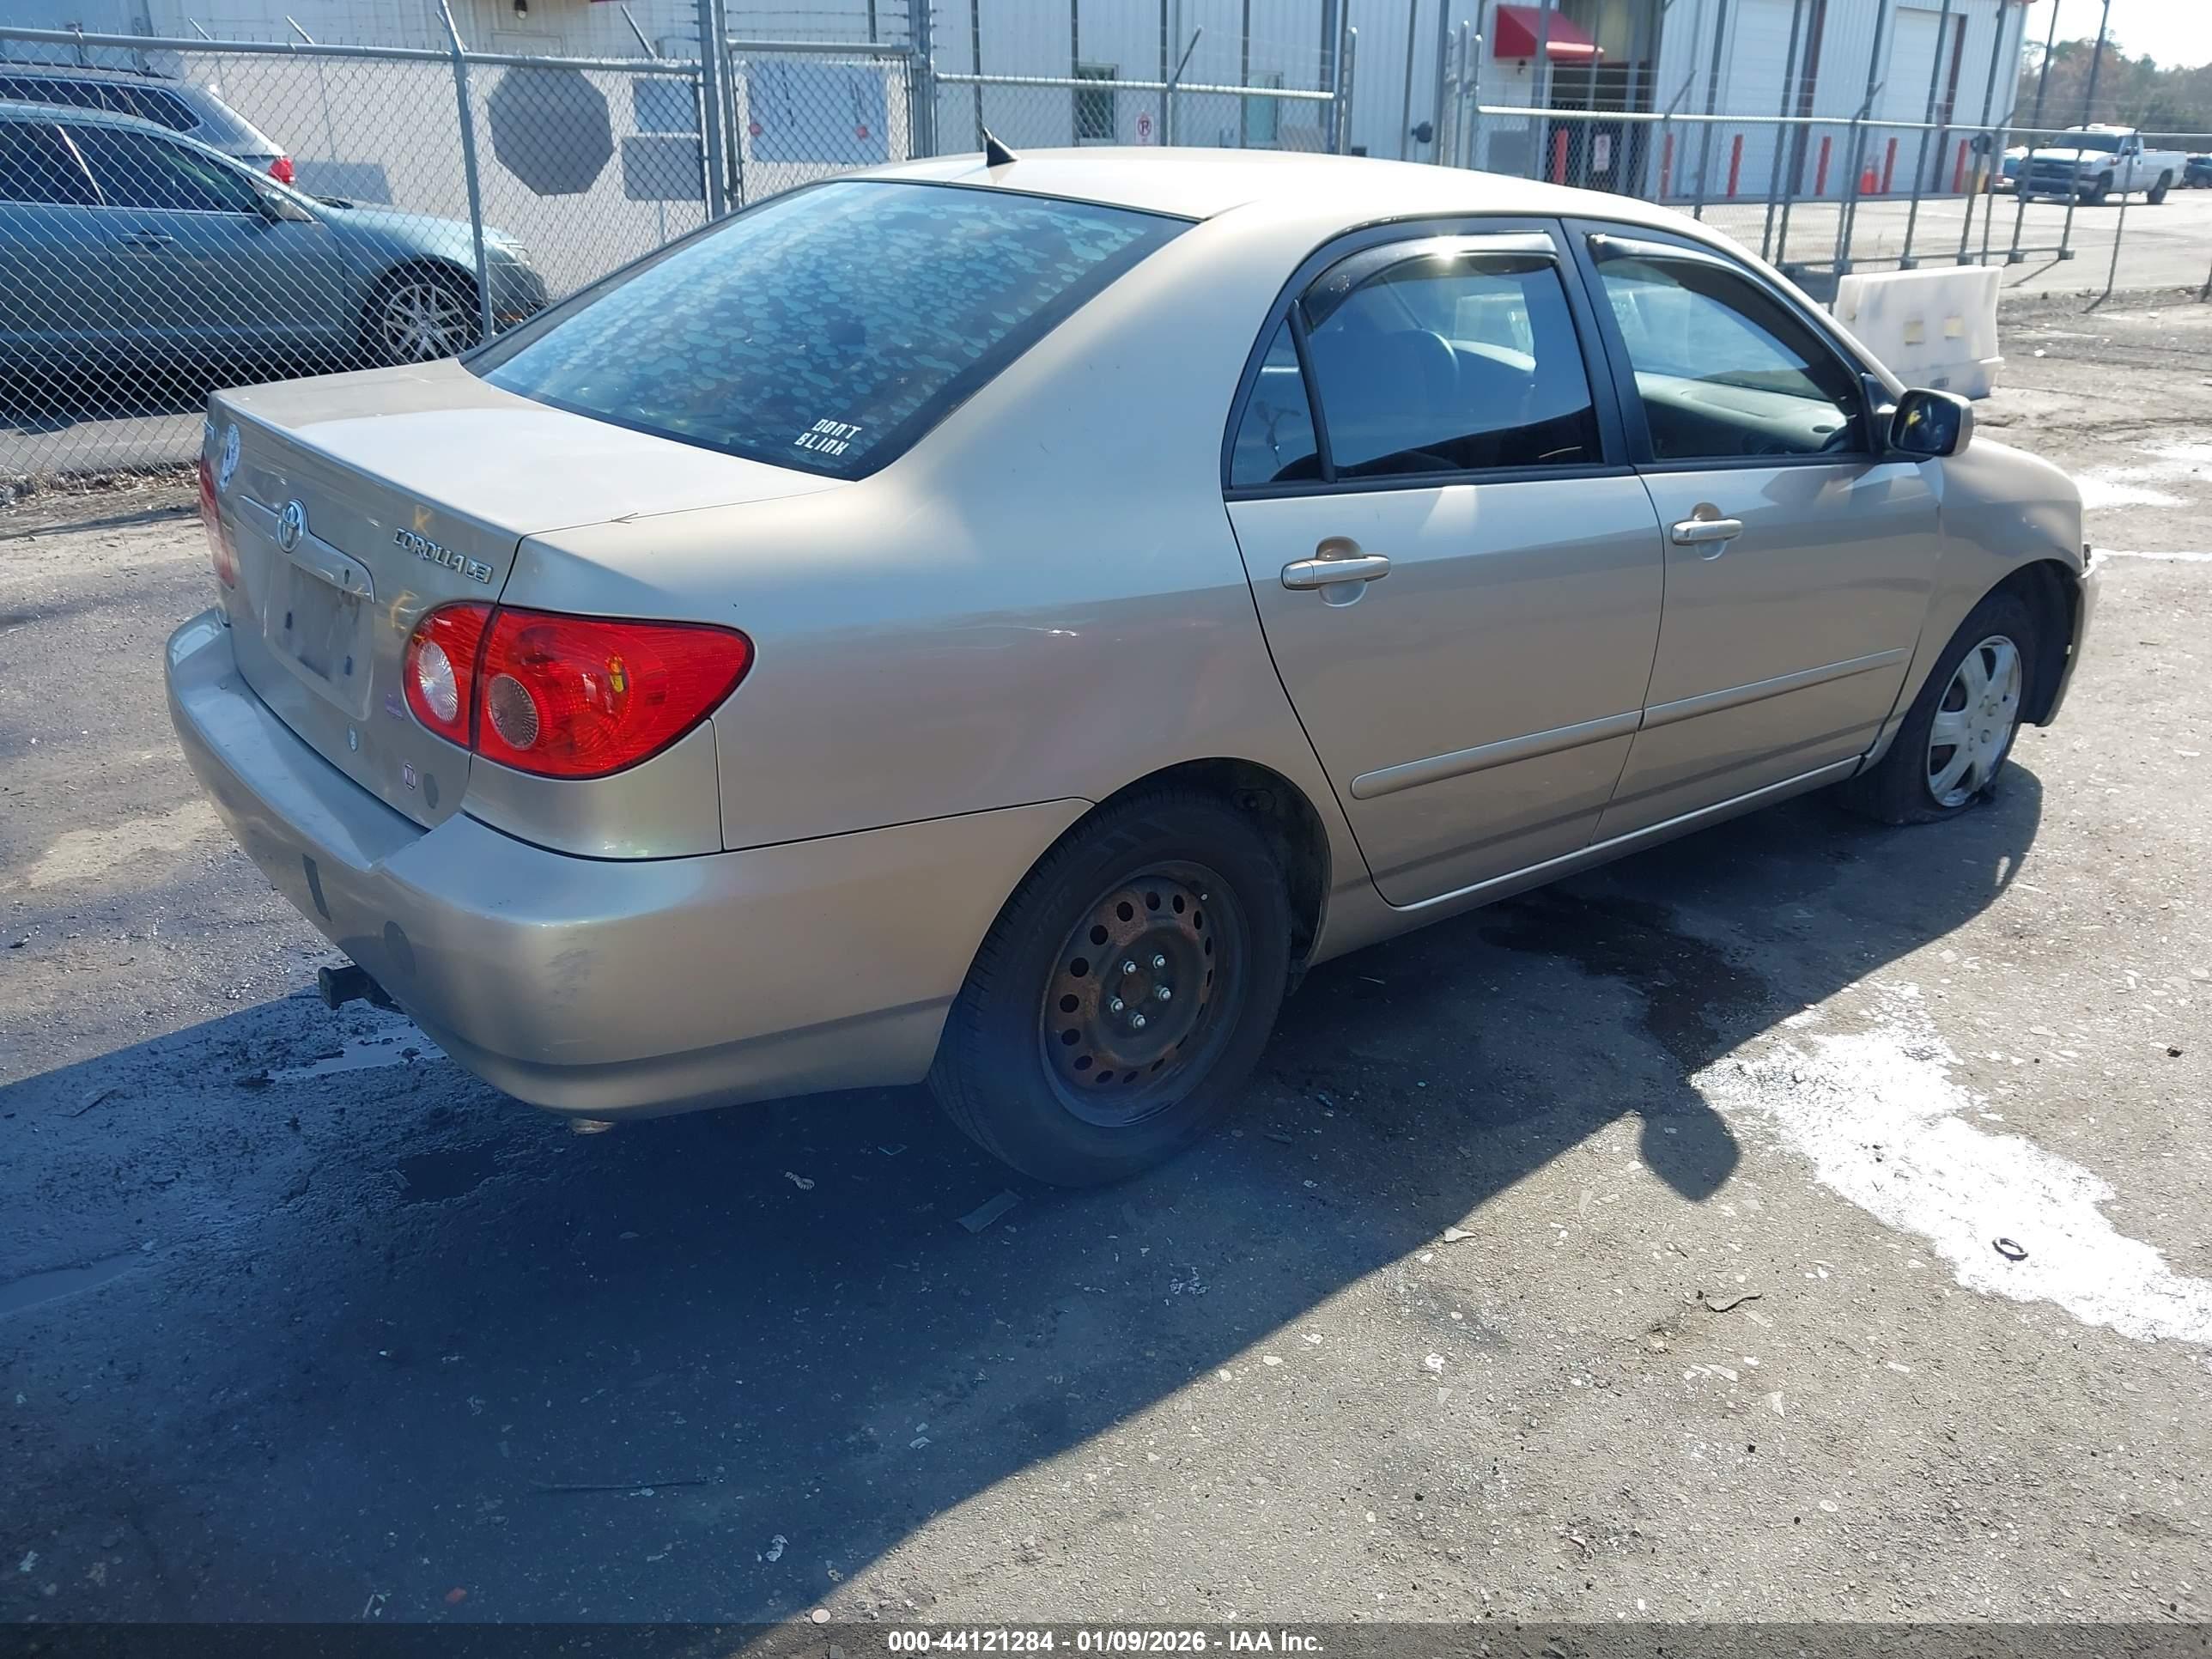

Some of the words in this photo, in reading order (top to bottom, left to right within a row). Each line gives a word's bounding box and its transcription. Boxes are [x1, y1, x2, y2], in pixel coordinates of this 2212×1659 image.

[811, 419, 862, 440] DON'T
[794, 433, 850, 456] BLINK
[392, 527, 466, 574] COROLLA
